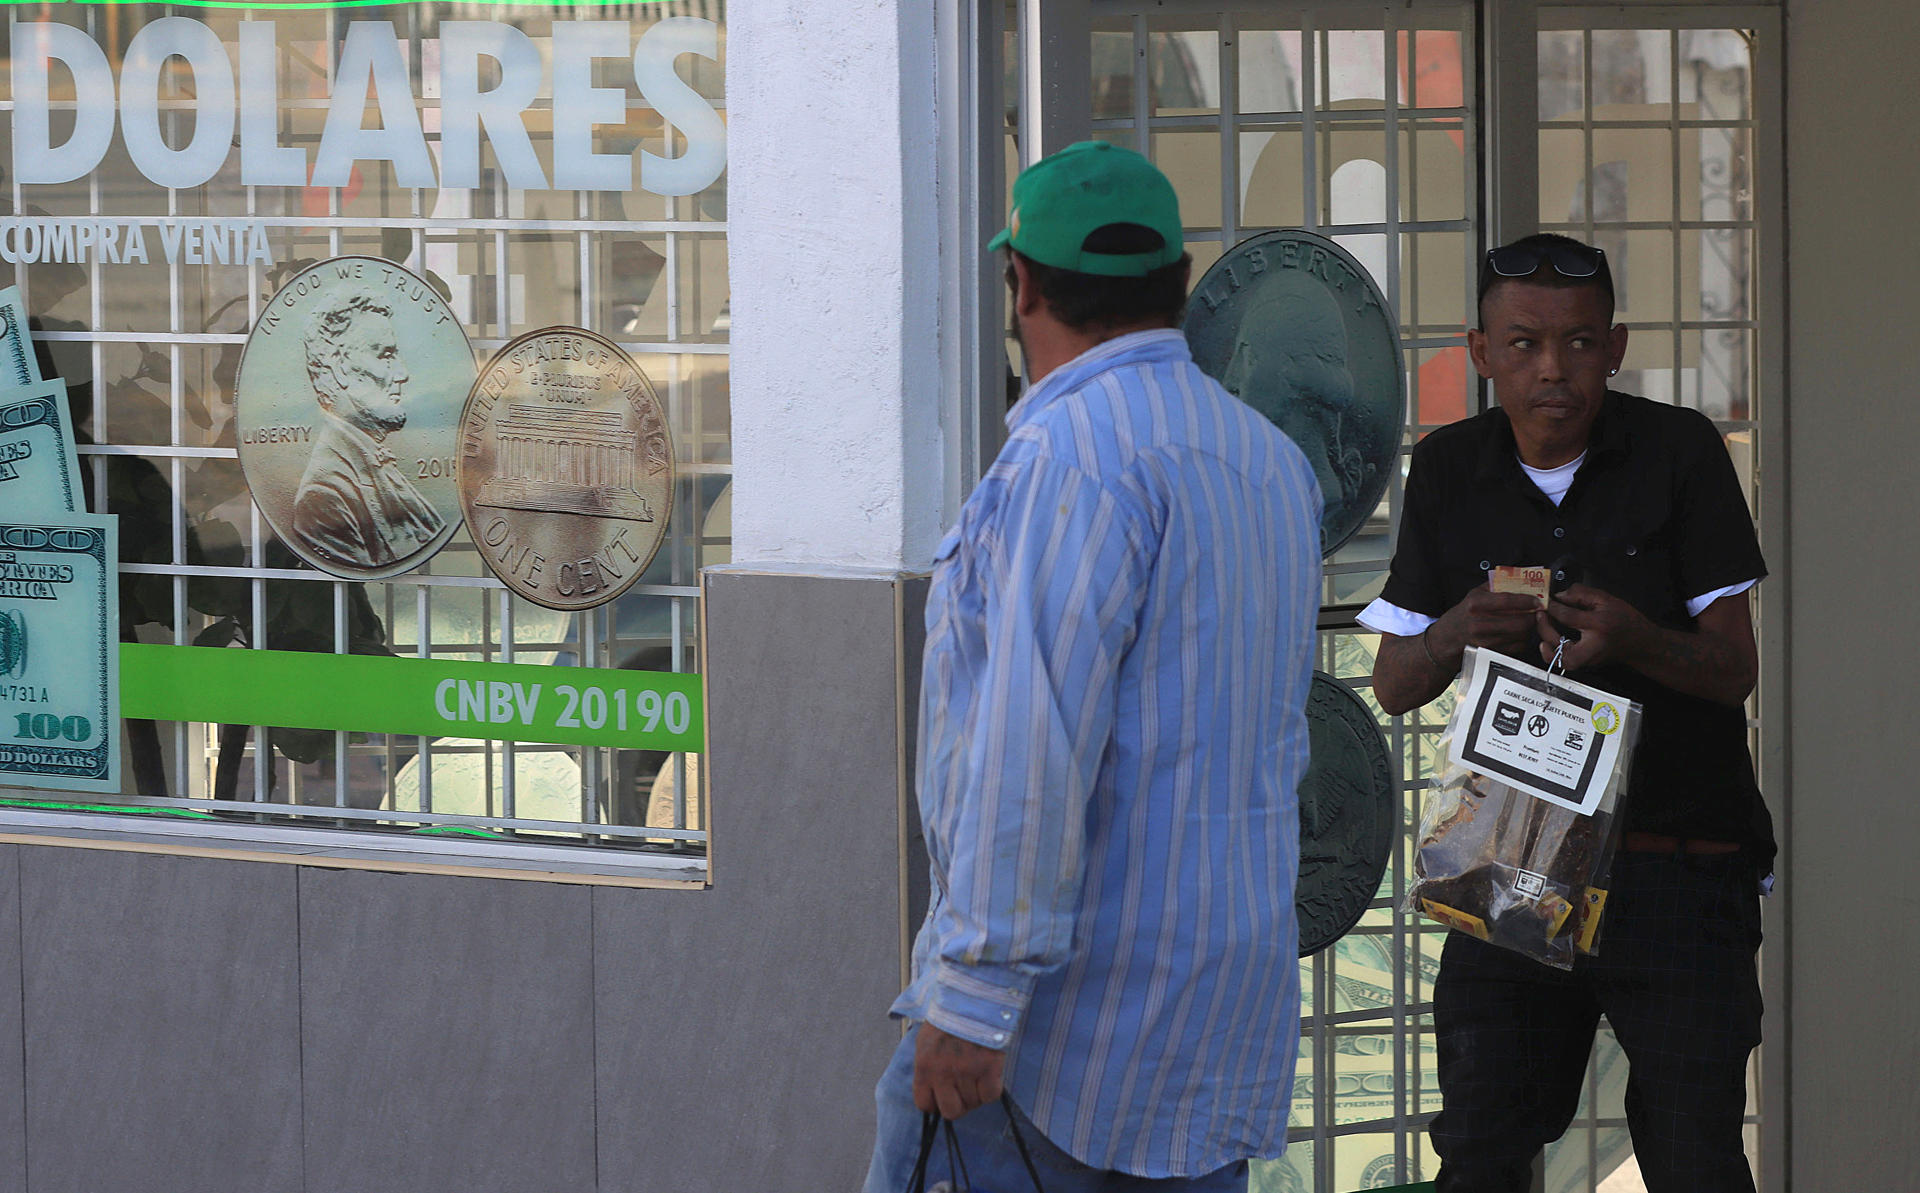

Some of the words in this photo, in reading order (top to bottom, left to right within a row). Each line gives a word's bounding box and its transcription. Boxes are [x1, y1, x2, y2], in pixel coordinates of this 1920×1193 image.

[10, 16, 726, 196] DOLARES
[0, 224, 148, 265] COMPRA
[158, 224, 272, 266] VENTA
[260, 313, 281, 336] IN
[285, 274, 321, 307] GOD
[337, 264, 362, 279] WE
[382, 268, 449, 326] TRUST
[1200, 240, 1378, 312] LIBERTY
[462, 366, 511, 458] UNITED
[511, 337, 583, 375] STATES
[585, 349, 609, 369] OF
[243, 426, 313, 445] LIBERTY
[482, 516, 546, 589] ONE
[556, 527, 639, 597] CENT
[1522, 570, 1544, 580] 100
[14, 712, 91, 742] 100
[435, 678, 541, 725] CNBV
[555, 684, 690, 735] 20190
[15, 752, 98, 768] DOLLARS
